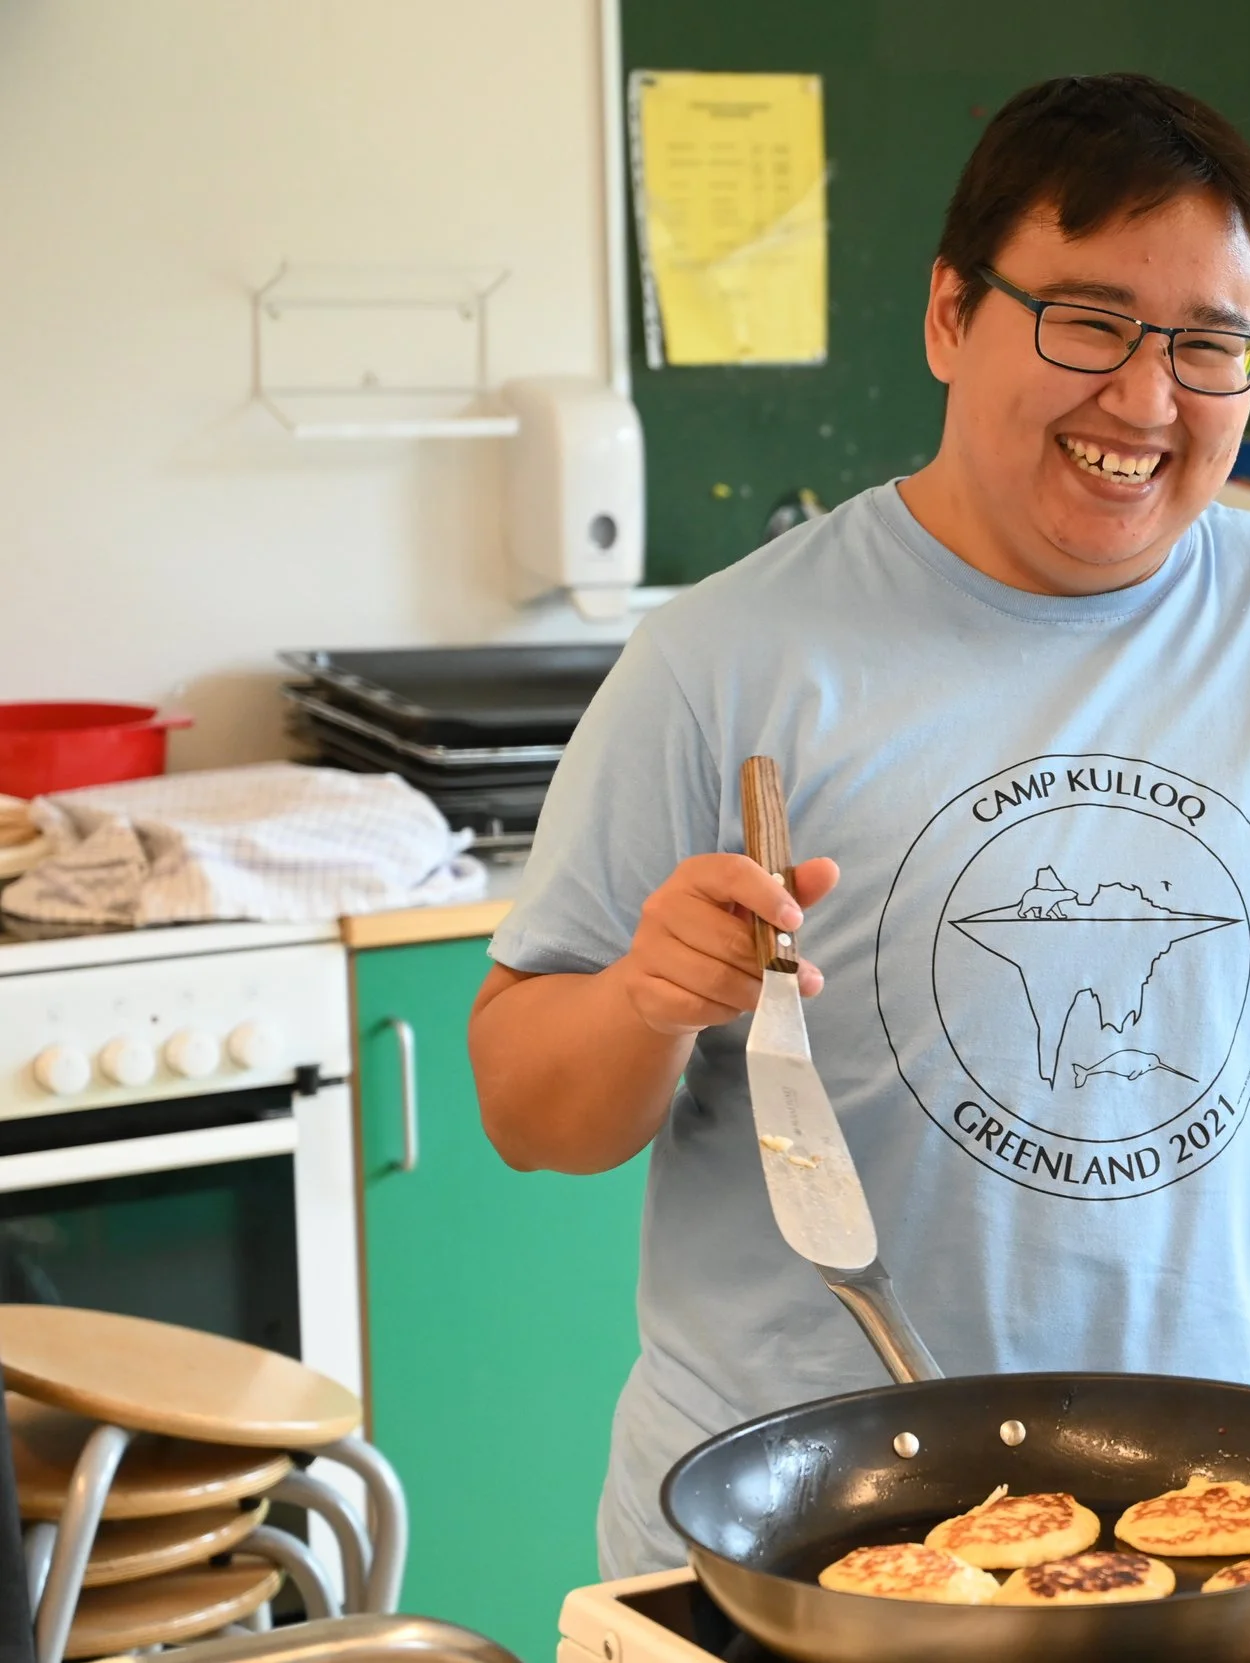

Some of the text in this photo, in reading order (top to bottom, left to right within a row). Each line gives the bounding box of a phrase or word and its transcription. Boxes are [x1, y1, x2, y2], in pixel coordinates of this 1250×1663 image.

[972, 768, 1206, 827] CAMP KULLOQ
[953, 1094, 1236, 1185] GREENLAND 2021
